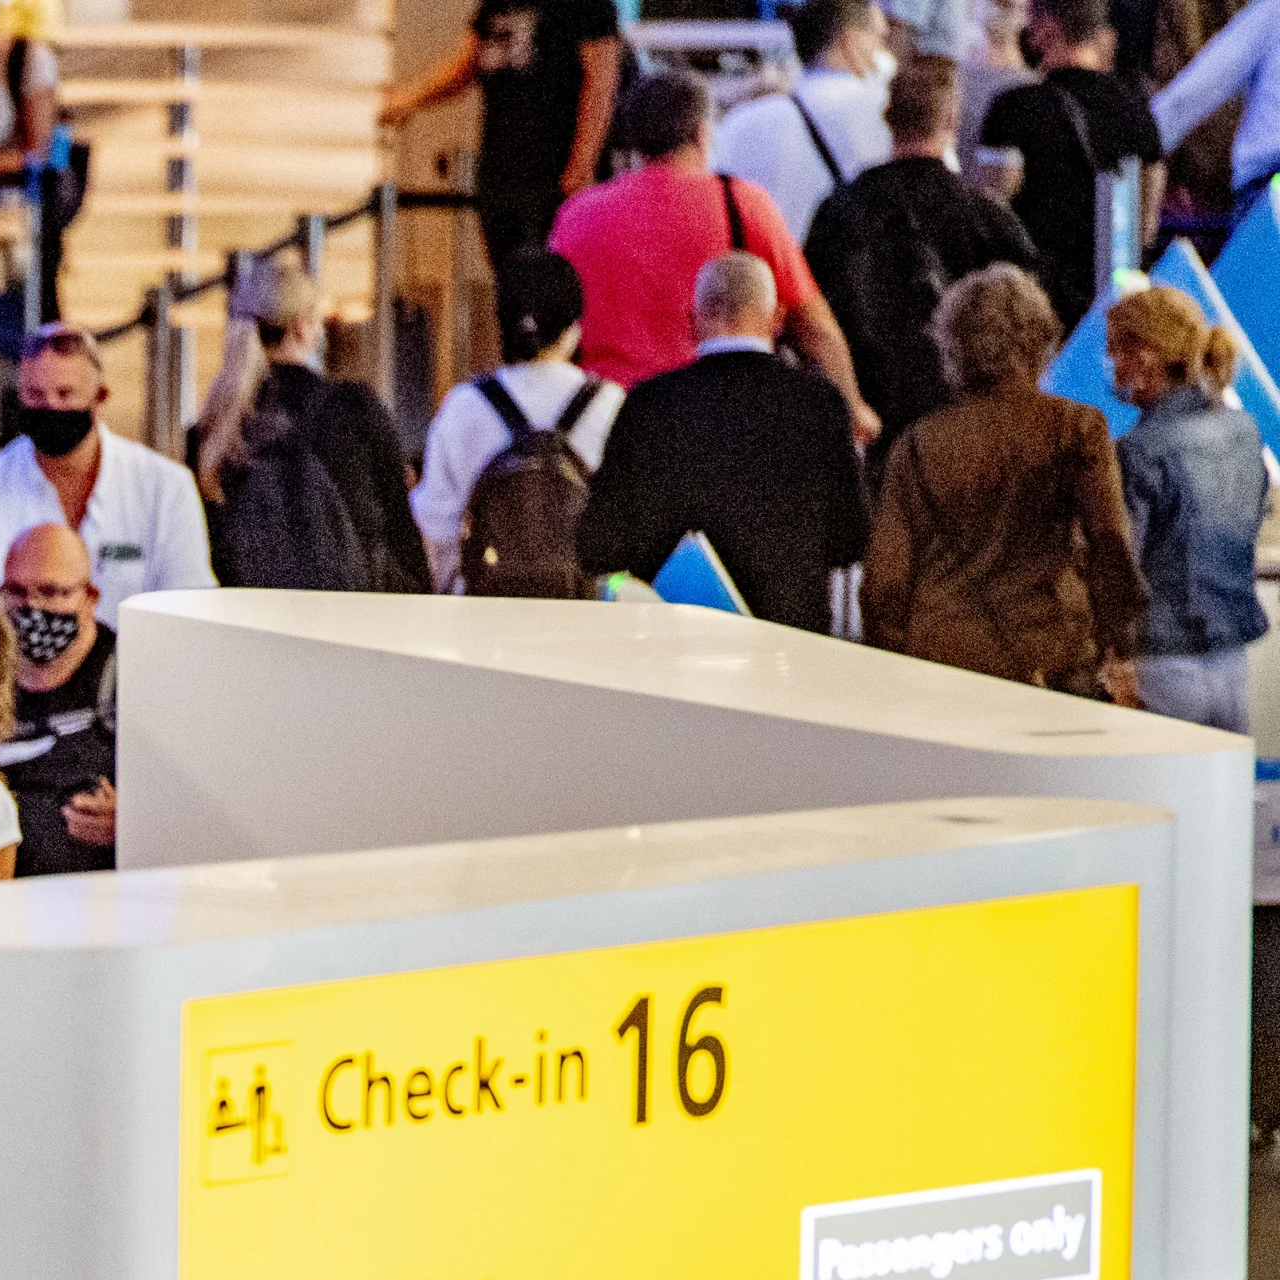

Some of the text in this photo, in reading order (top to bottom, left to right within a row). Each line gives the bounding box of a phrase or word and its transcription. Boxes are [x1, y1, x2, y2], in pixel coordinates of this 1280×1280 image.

[321, 986, 725, 1131] Check-in 16
[1009, 1204, 1087, 1261] only
